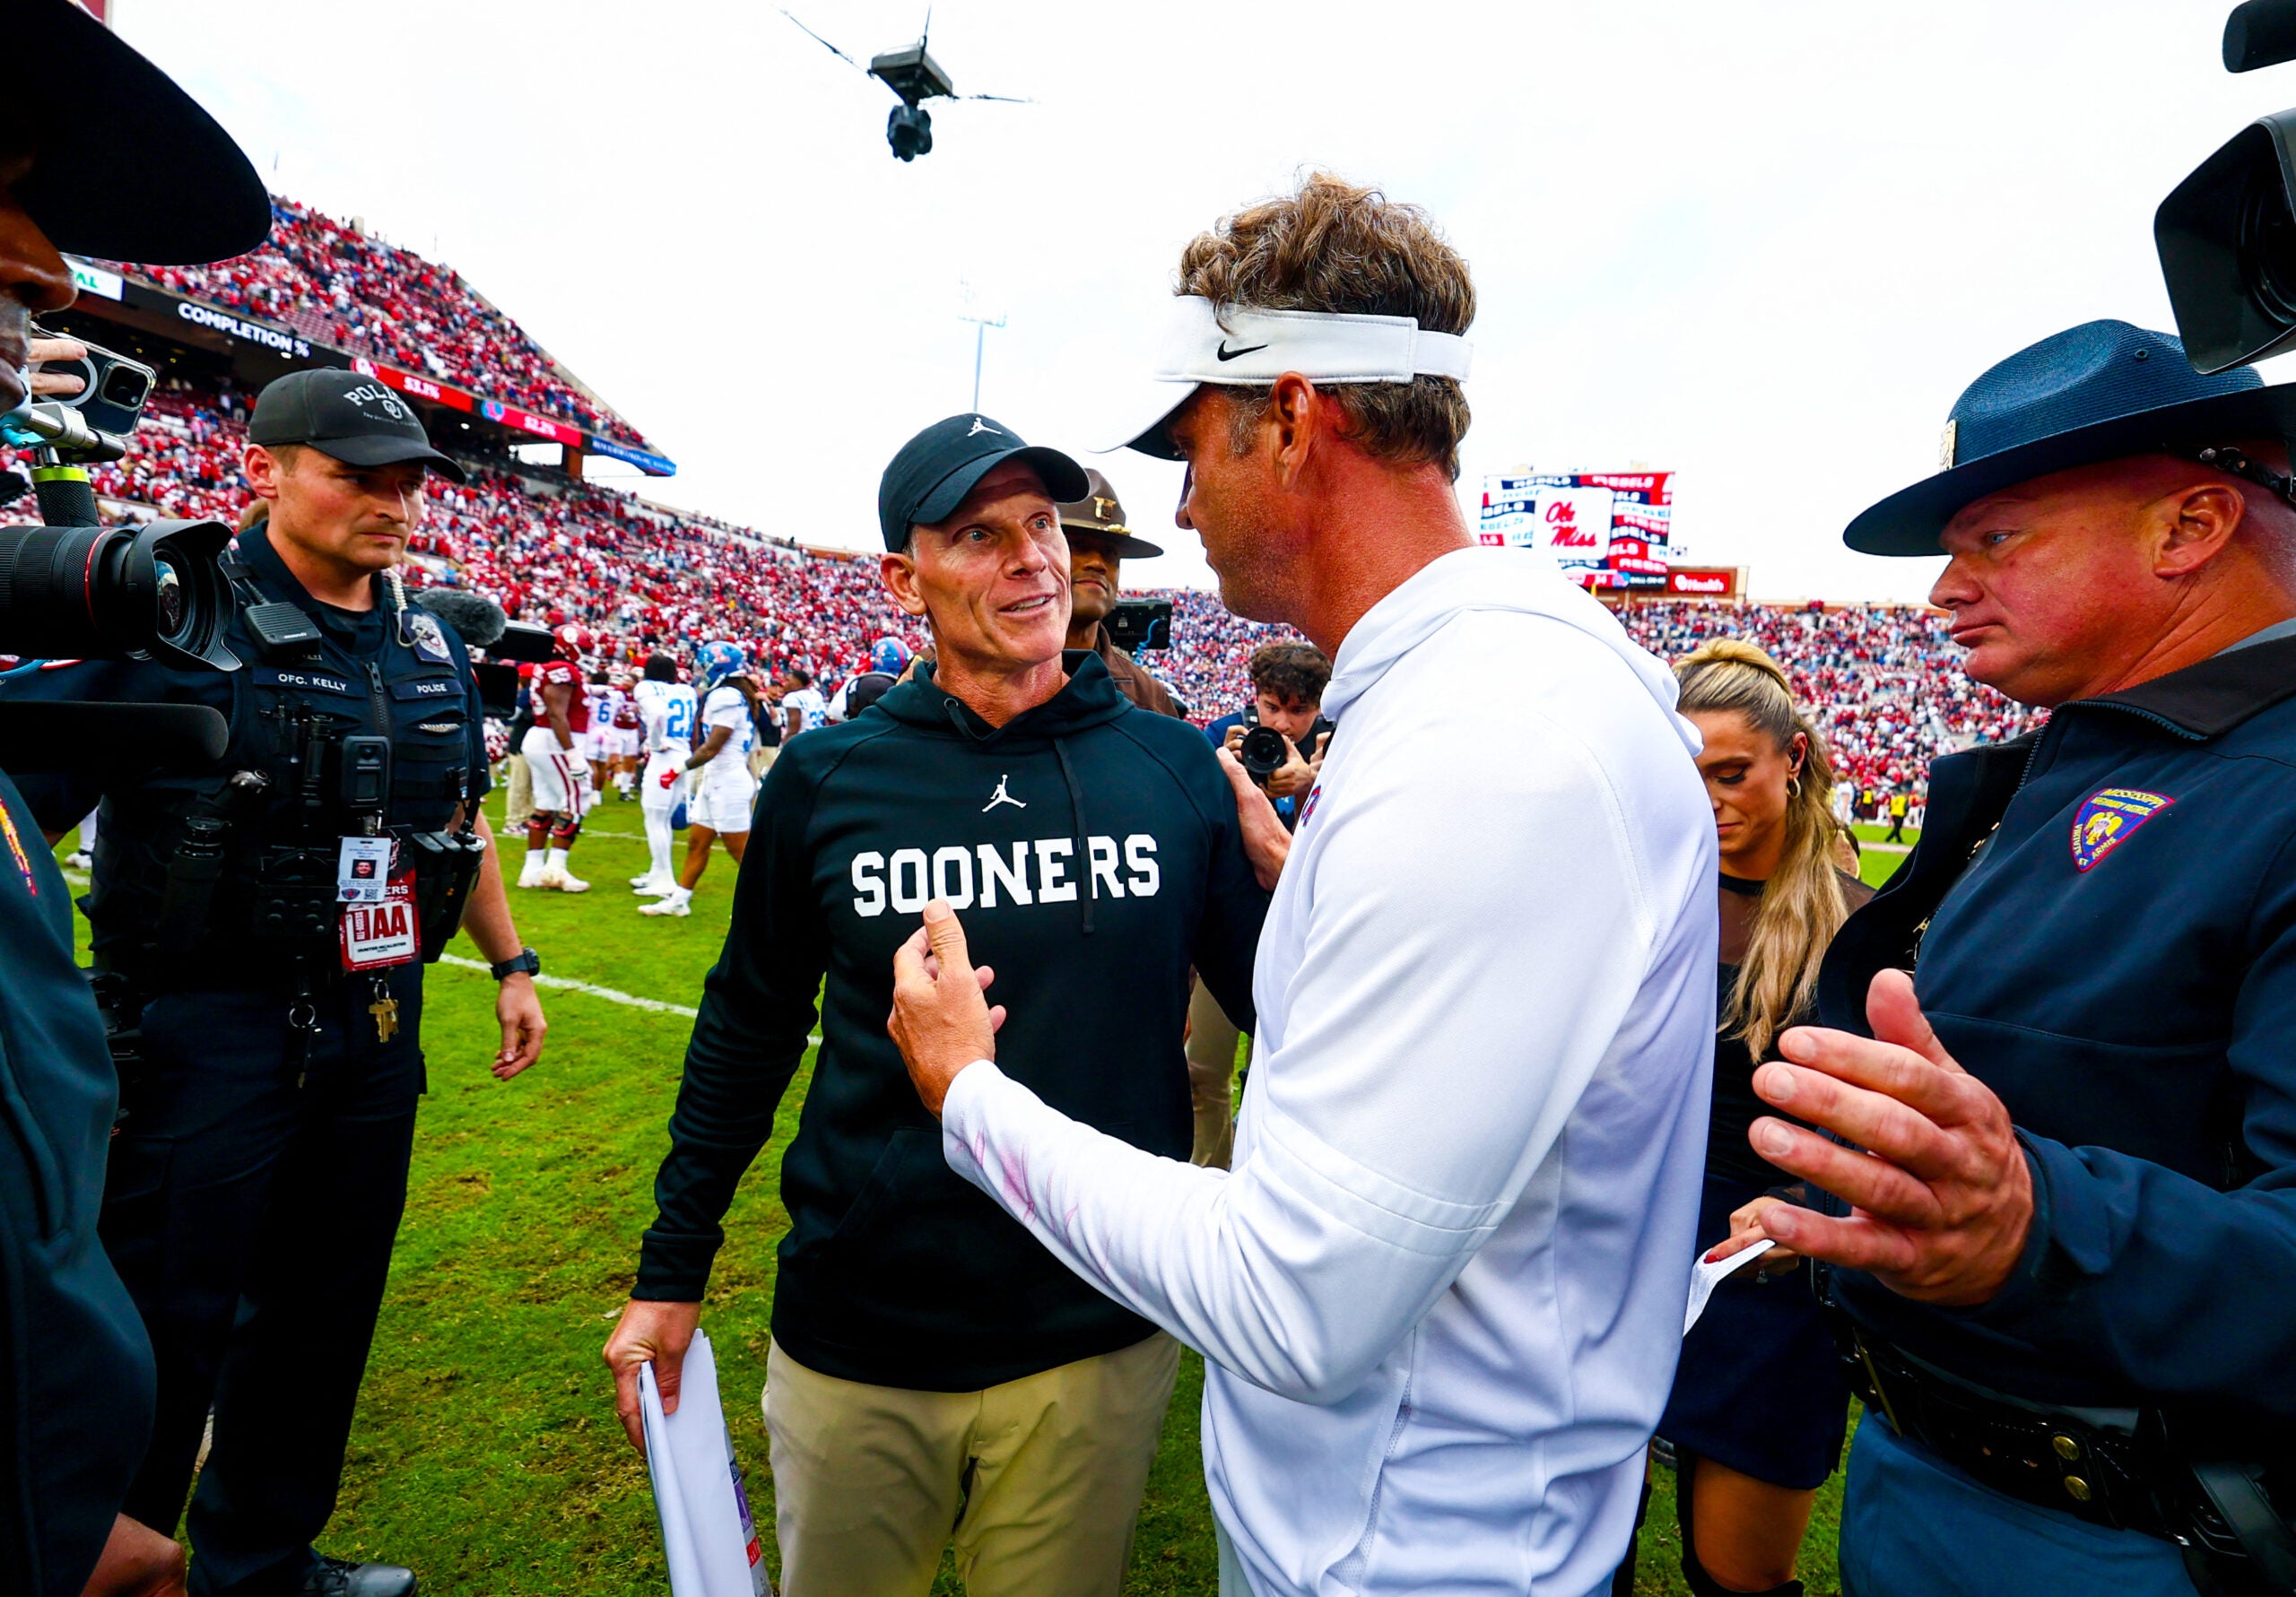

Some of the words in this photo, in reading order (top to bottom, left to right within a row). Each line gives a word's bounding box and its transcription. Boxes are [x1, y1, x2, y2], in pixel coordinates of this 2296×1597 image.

[178, 301, 293, 352] COMPLETION
[293, 340, 310, 358] %
[1544, 500, 1576, 523] Ole
[1550, 525, 1597, 547] Miss
[1688, 578, 1725, 592] Health
[277, 673, 308, 686] OFC.
[312, 677, 347, 692] KELLY
[416, 683, 448, 694] POLICE
[597, 701, 612, 723] 6
[666, 699, 694, 737] 21
[851, 834, 1161, 917] SOONERS
